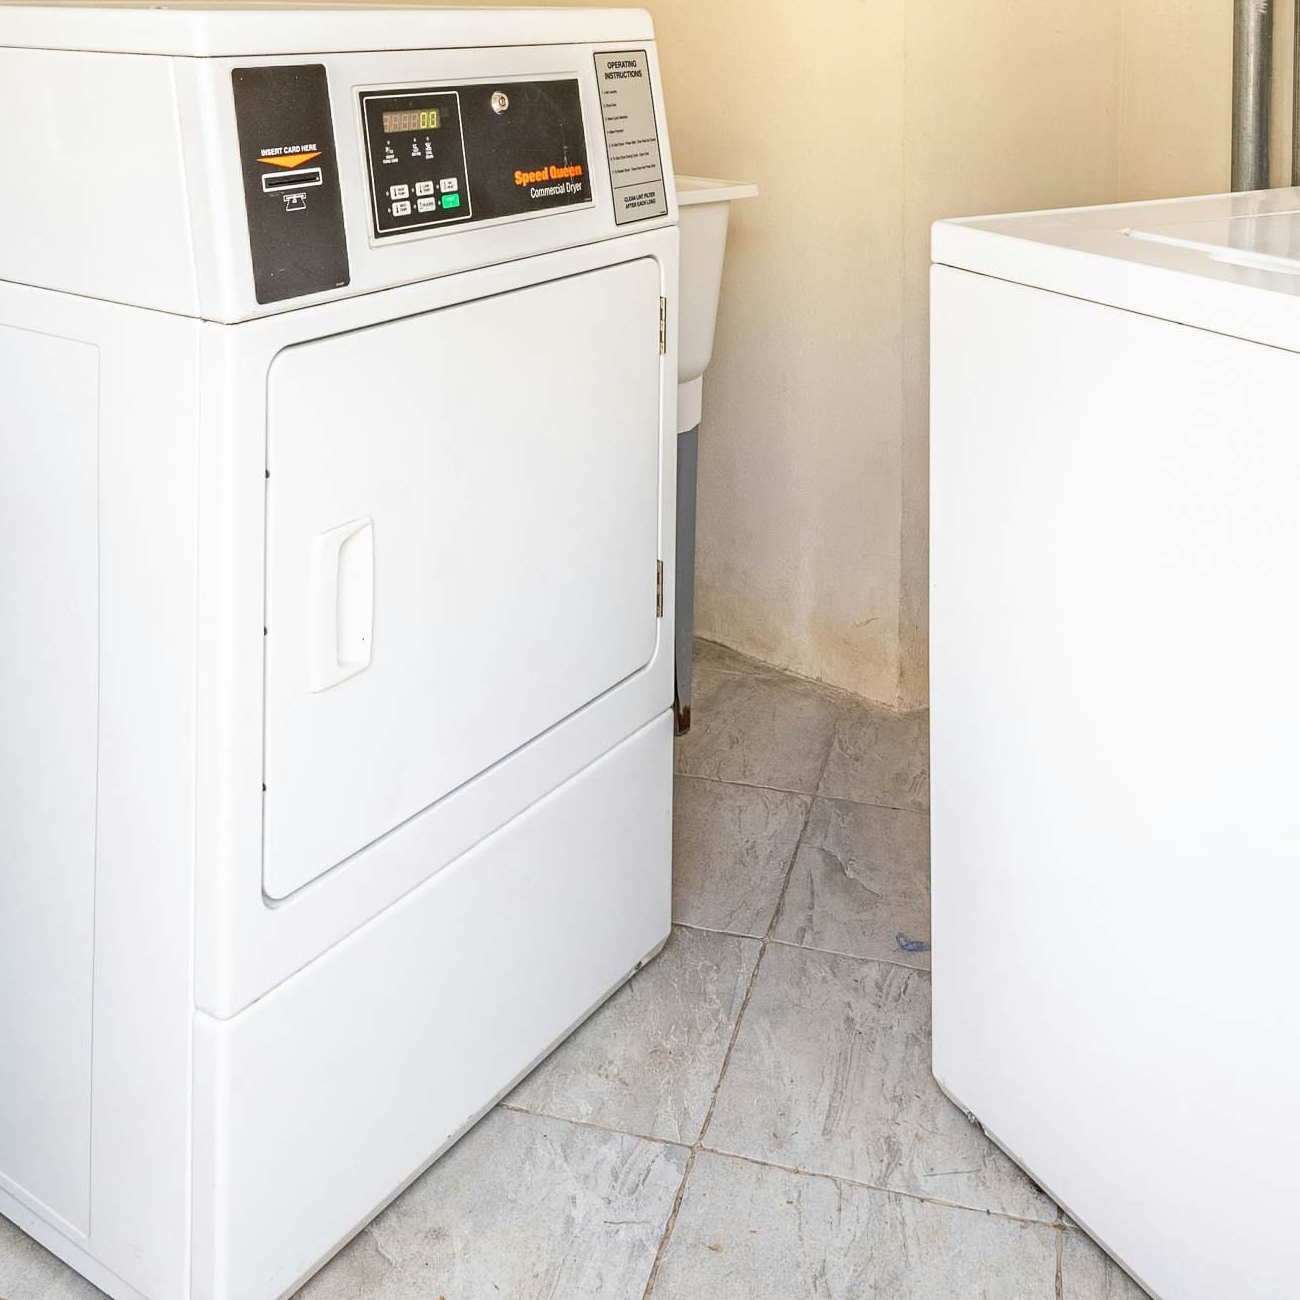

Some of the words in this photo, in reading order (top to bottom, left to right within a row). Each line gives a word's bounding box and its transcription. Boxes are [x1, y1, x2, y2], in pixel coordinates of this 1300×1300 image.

[607, 60, 637, 69] OPERATING
[604, 70, 643, 80] INSTRUCTIONS
[261, 146, 283, 157] INSERT
[283, 145, 300, 154] CARD
[300, 143, 317, 152] HERE
[514, 167, 549, 187] Speed
[549, 164, 583, 180] Queen
[530, 182, 566, 199] Commercial
[566, 181, 582, 195] Dryer
